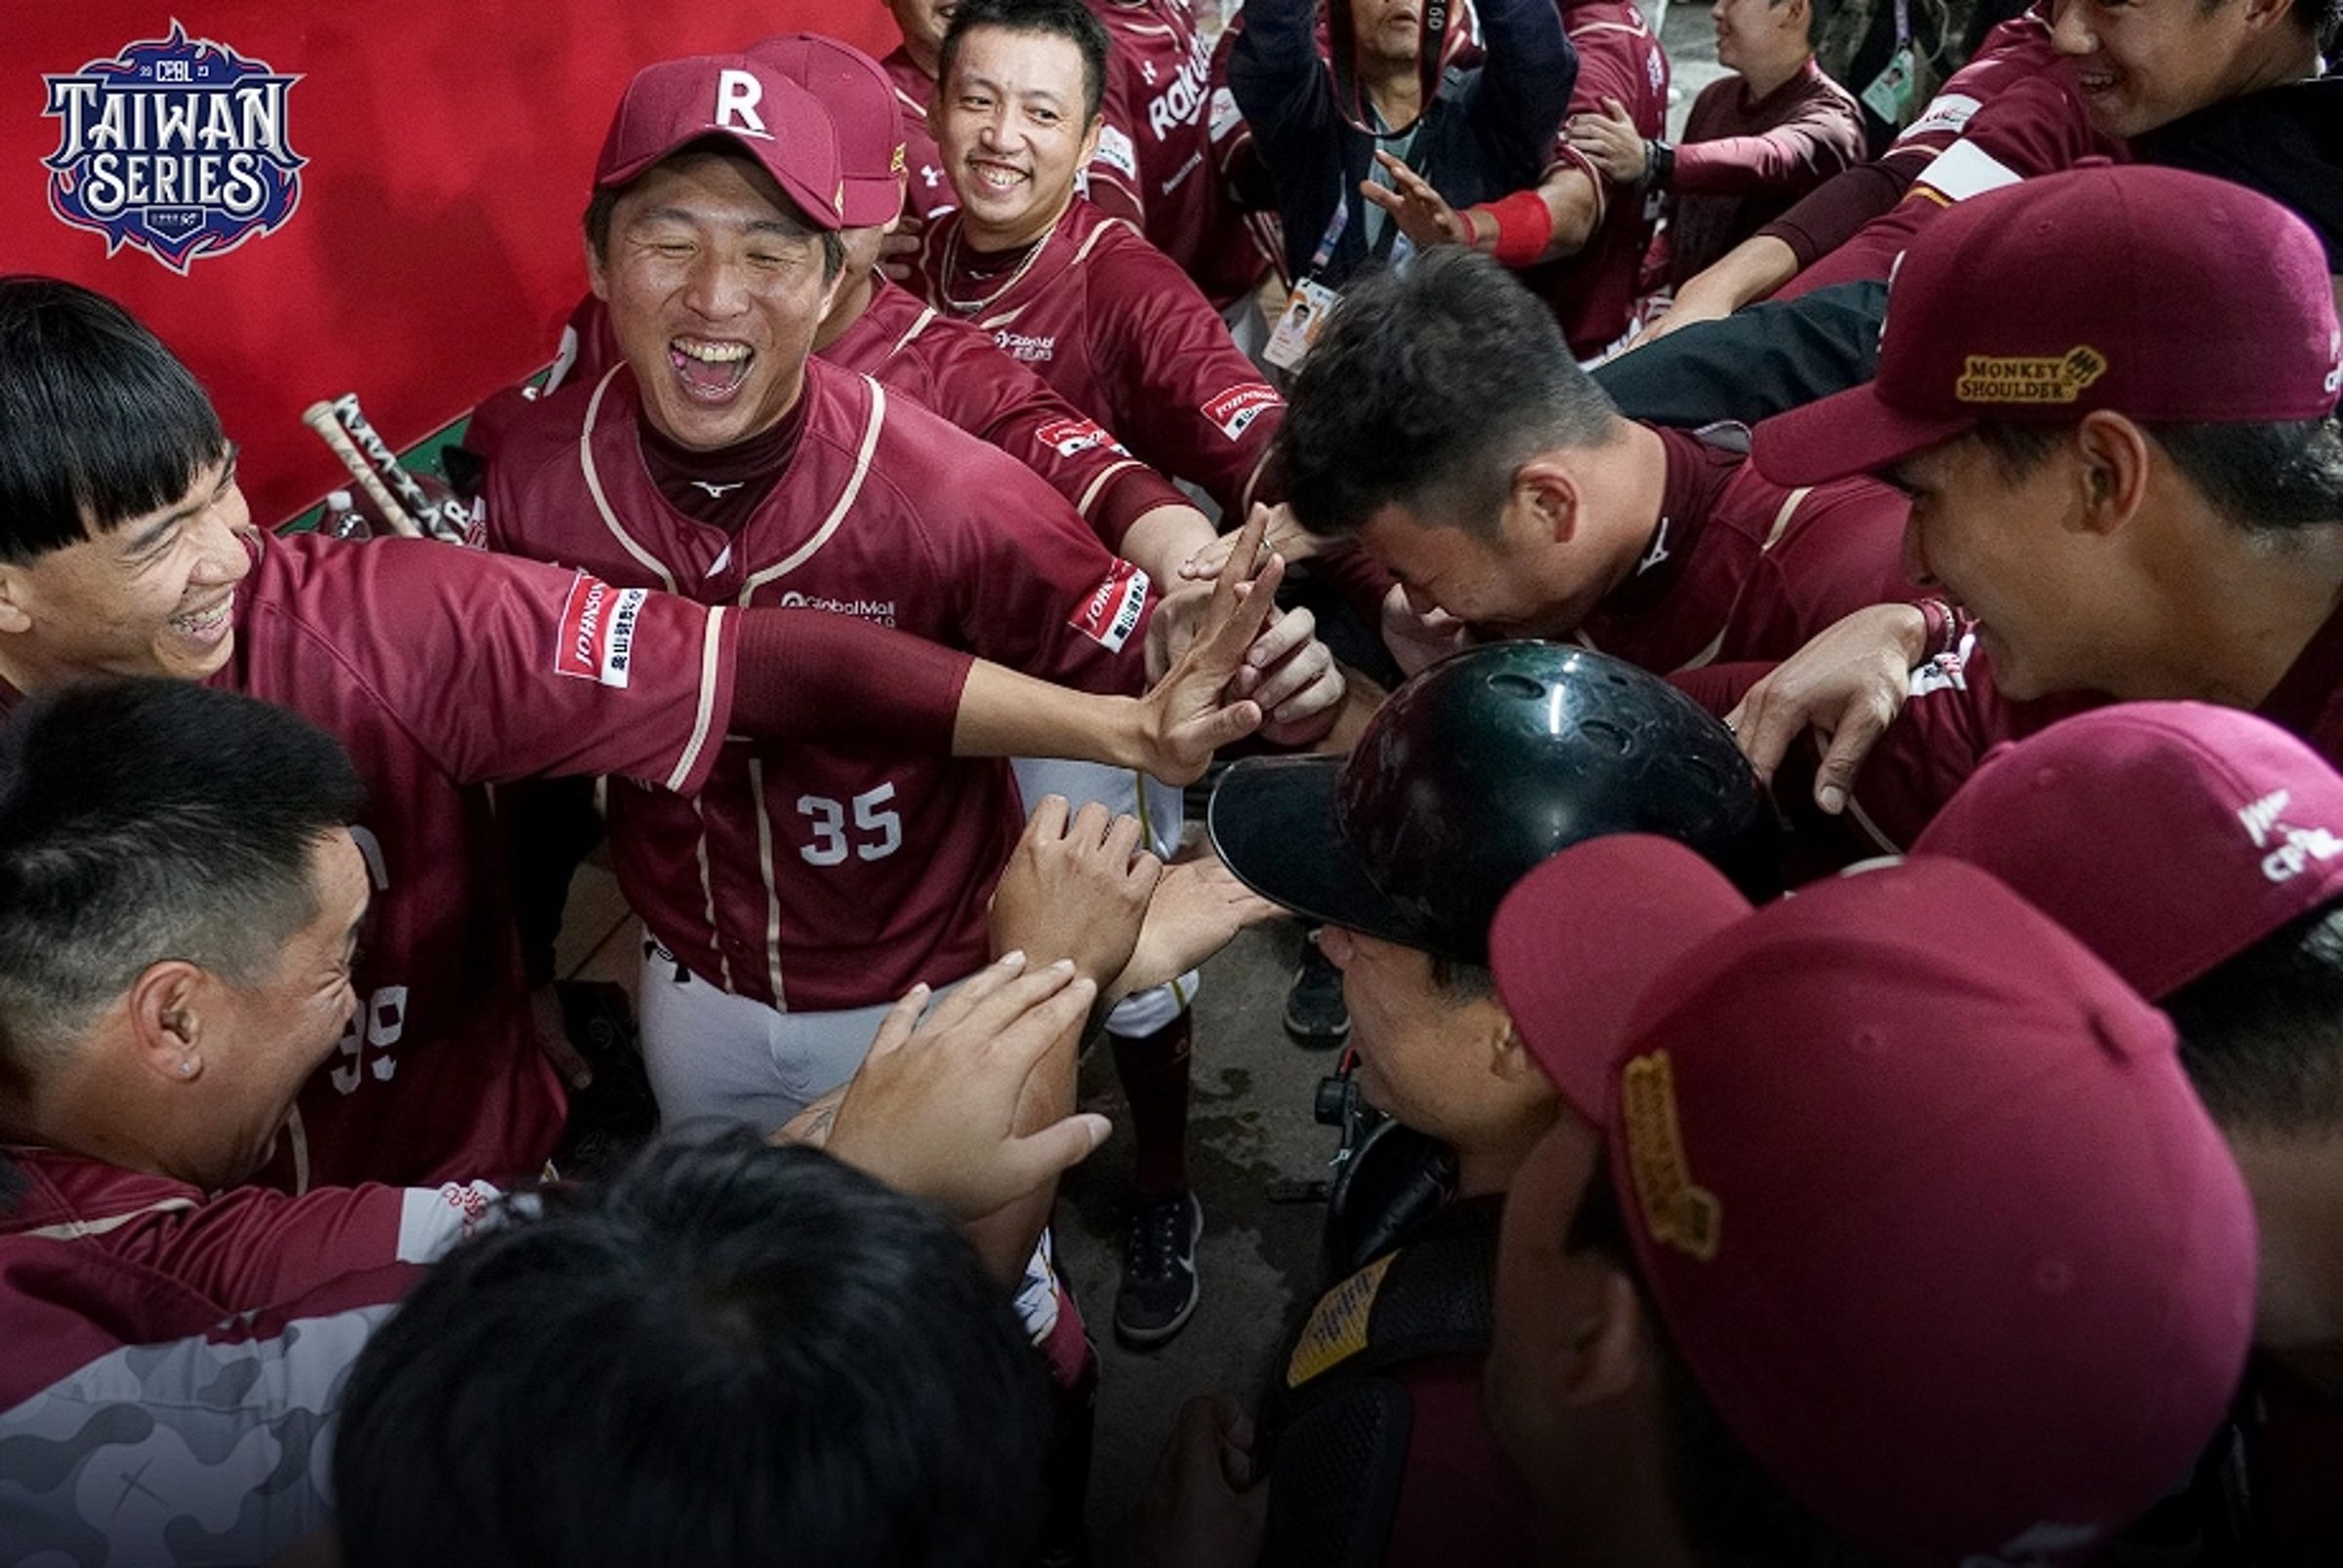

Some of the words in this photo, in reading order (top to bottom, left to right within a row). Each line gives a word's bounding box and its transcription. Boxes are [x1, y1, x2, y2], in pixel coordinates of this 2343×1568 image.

[716, 69, 766, 131] R
[1960, 380, 2064, 399] SHOULDER
[1970, 360, 2060, 379] MONKEY
[796, 781, 903, 867] 35
